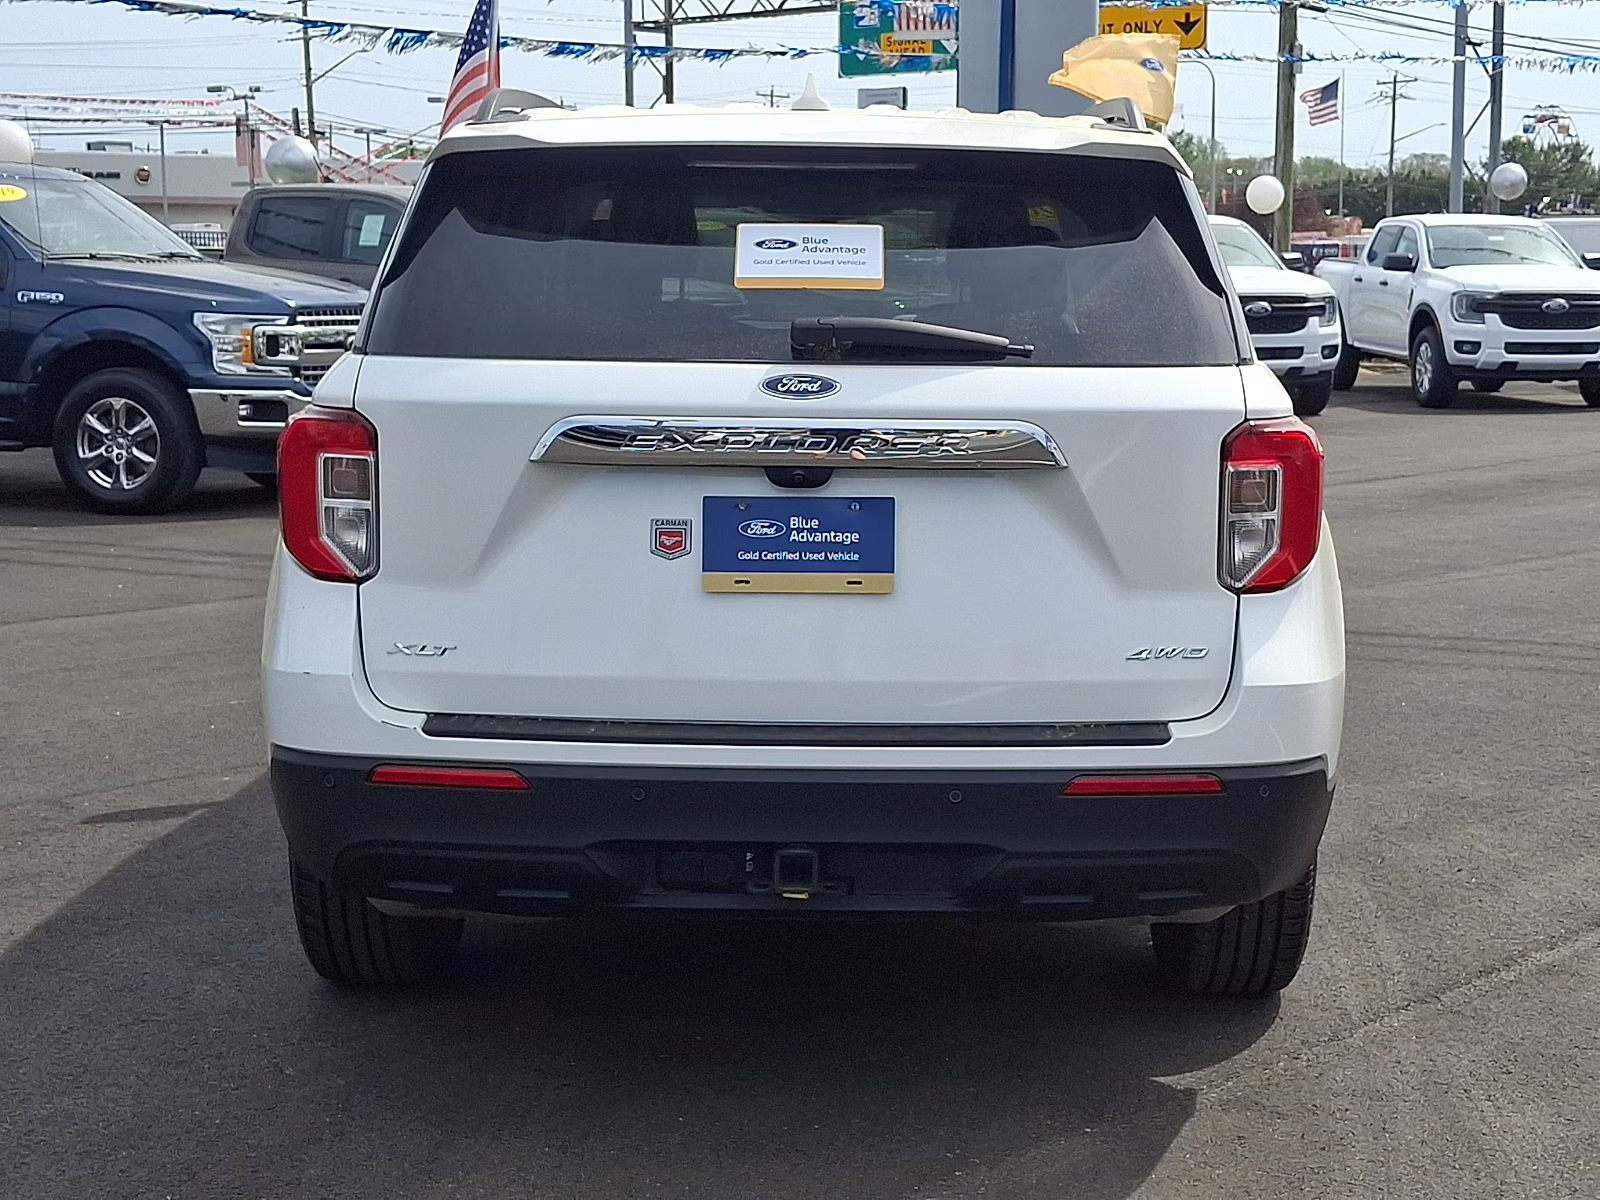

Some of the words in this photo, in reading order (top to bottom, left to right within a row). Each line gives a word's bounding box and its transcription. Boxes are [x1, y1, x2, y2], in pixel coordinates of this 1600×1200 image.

[1102, 23, 1114, 34] IT
[1123, 19, 1163, 34] ONLY
[802, 236, 829, 245] Blue
[802, 246, 866, 255] Advantage
[753, 258, 773, 266] Gold
[775, 258, 810, 266] Certified
[812, 258, 835, 266] Used
[777, 376, 822, 394] Ford
[621, 432, 973, 457] EXPLORER
[654, 519, 688, 527] CARMAN
[789, 516, 820, 529] Blue
[789, 530, 860, 545] Advantage
[737, 550, 760, 561] Gold
[761, 550, 800, 561] Certified
[802, 551, 826, 561] Used
[827, 551, 860, 561] Vehicle
[386, 641, 458, 657] XLT
[1125, 645, 1210, 661] 4WD
